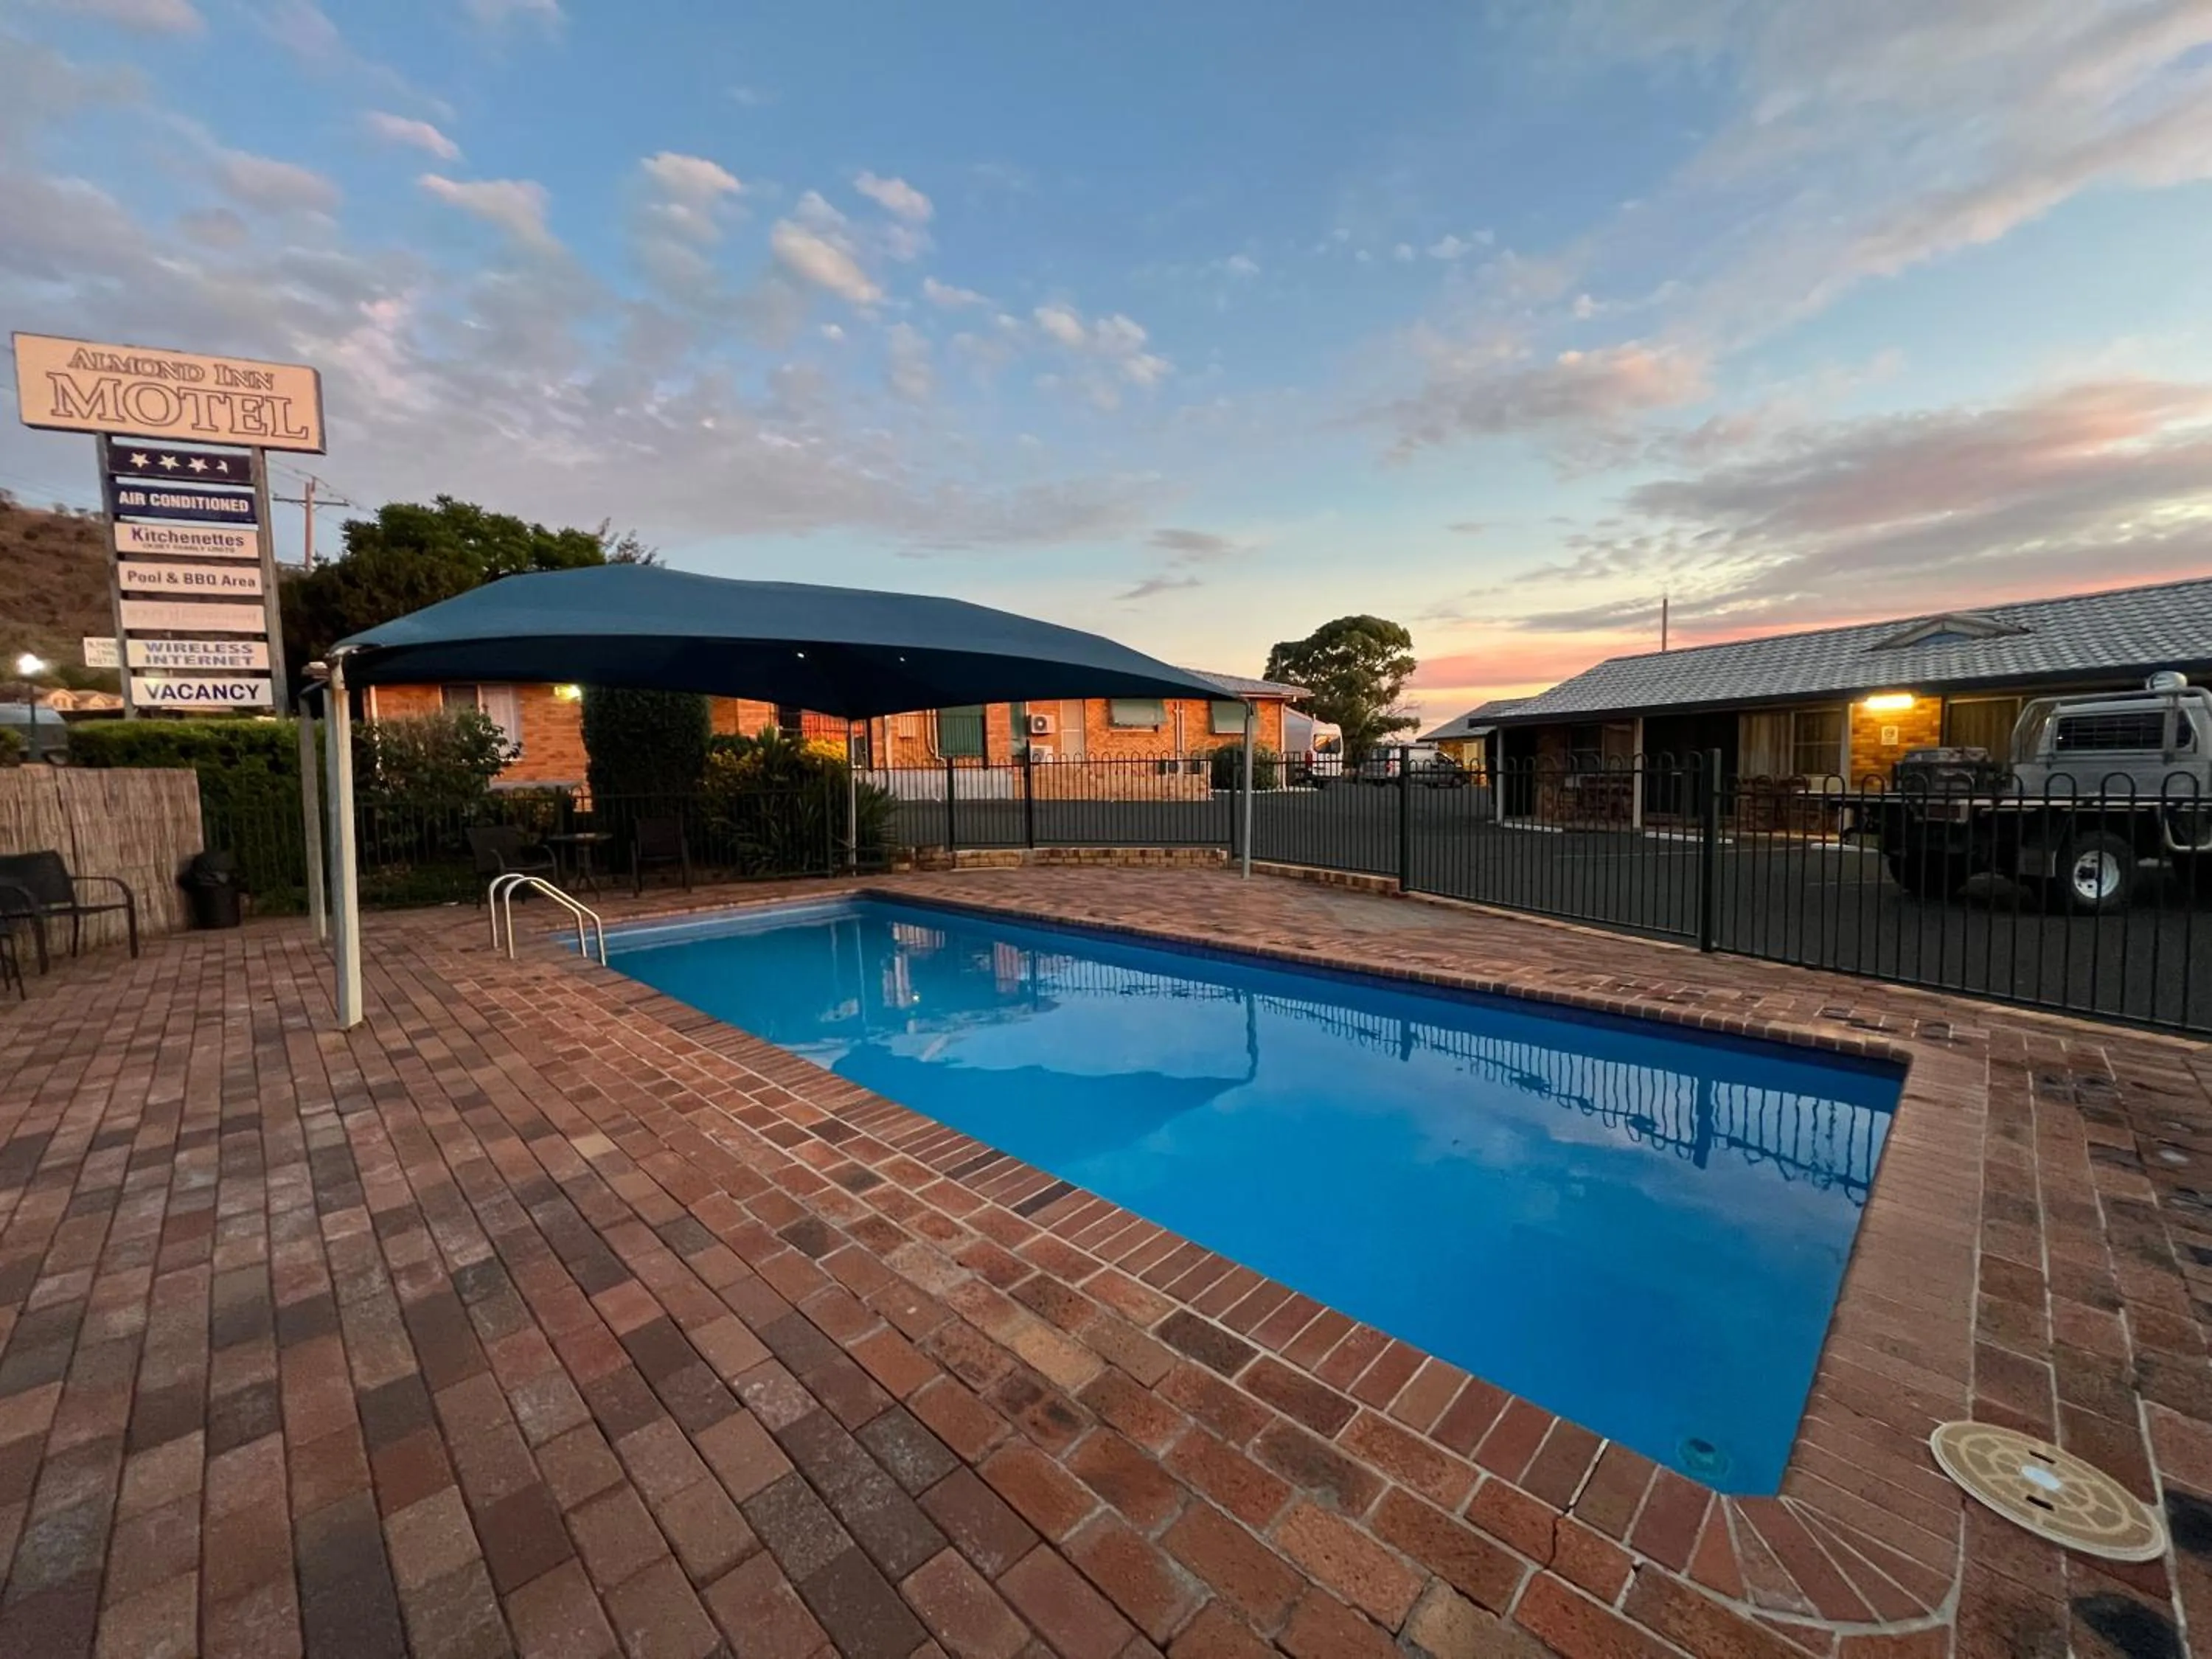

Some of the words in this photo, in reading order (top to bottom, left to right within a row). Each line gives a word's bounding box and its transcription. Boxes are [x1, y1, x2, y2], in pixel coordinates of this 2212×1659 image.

[67, 347, 206, 382] ALMOND
[214, 364, 274, 391] INN
[46, 372, 309, 440] MOTEL
[119, 491, 145, 506] AIR
[150, 493, 249, 512] CONDITIONED
[131, 526, 245, 547] Kitchenettes
[128, 570, 161, 583] Pool
[166, 573, 178, 584] &
[184, 573, 216, 586] BBQ
[222, 575, 256, 588] Area
[145, 641, 254, 654] WIRELESS
[145, 654, 254, 666] INTERNET
[145, 684, 260, 700] VACANCY
